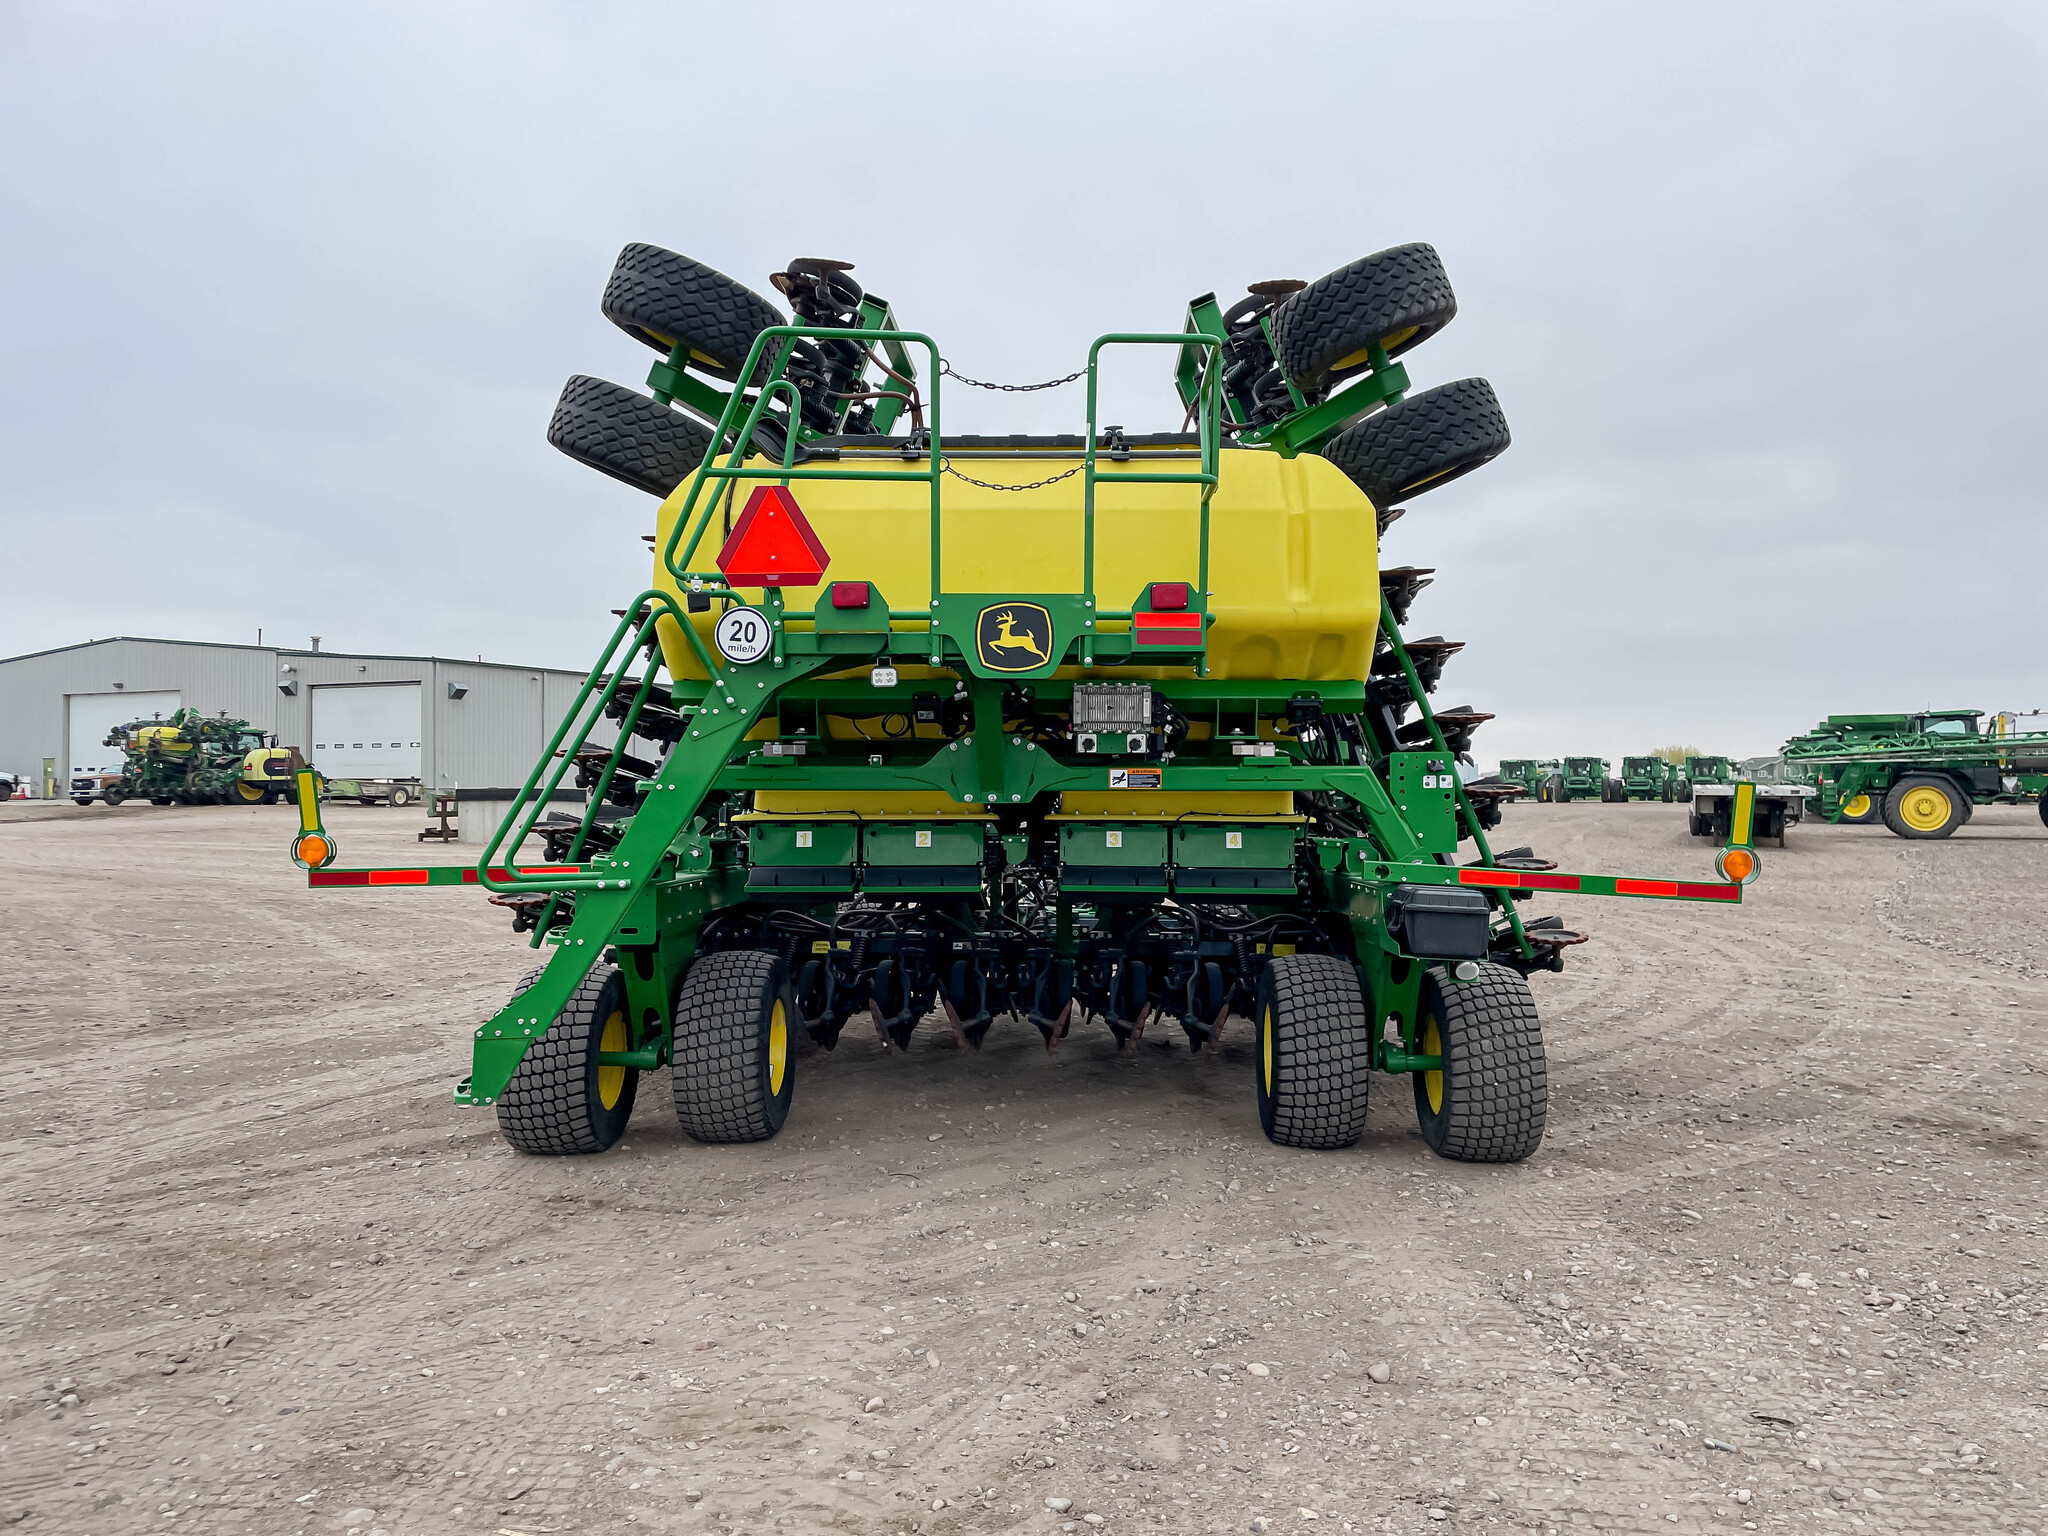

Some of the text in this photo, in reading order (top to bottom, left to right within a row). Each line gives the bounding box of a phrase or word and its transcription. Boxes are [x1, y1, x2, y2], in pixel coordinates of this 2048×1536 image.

[729, 620, 757, 643] 20
[728, 644, 756, 653] mile/h
[800, 832, 807, 846] 1
[918, 832, 928, 846] 2
[1109, 832, 1119, 846] 3
[1229, 833, 1239, 847] 4
